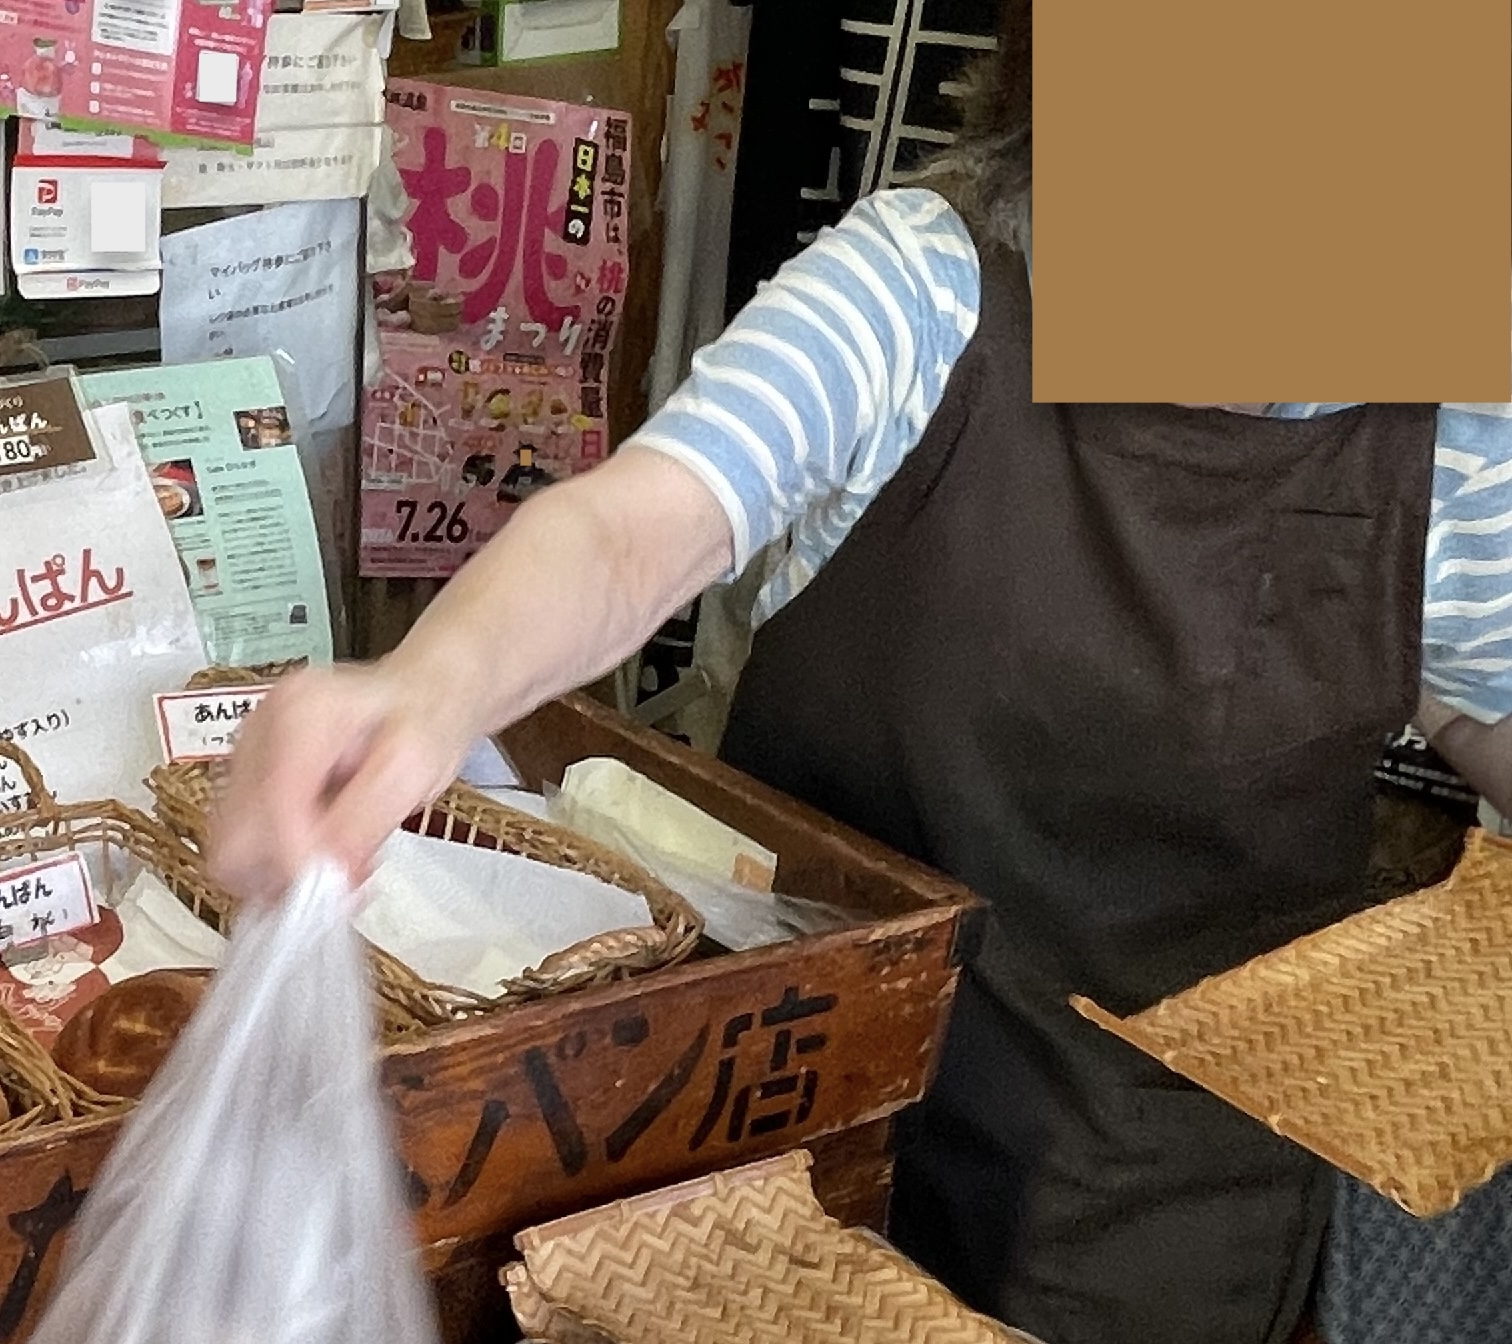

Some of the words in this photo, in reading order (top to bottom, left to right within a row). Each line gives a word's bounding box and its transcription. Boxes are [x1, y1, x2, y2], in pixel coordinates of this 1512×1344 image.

[480, 306, 582, 355] まつり
[395, 500, 469, 544] 7.26
